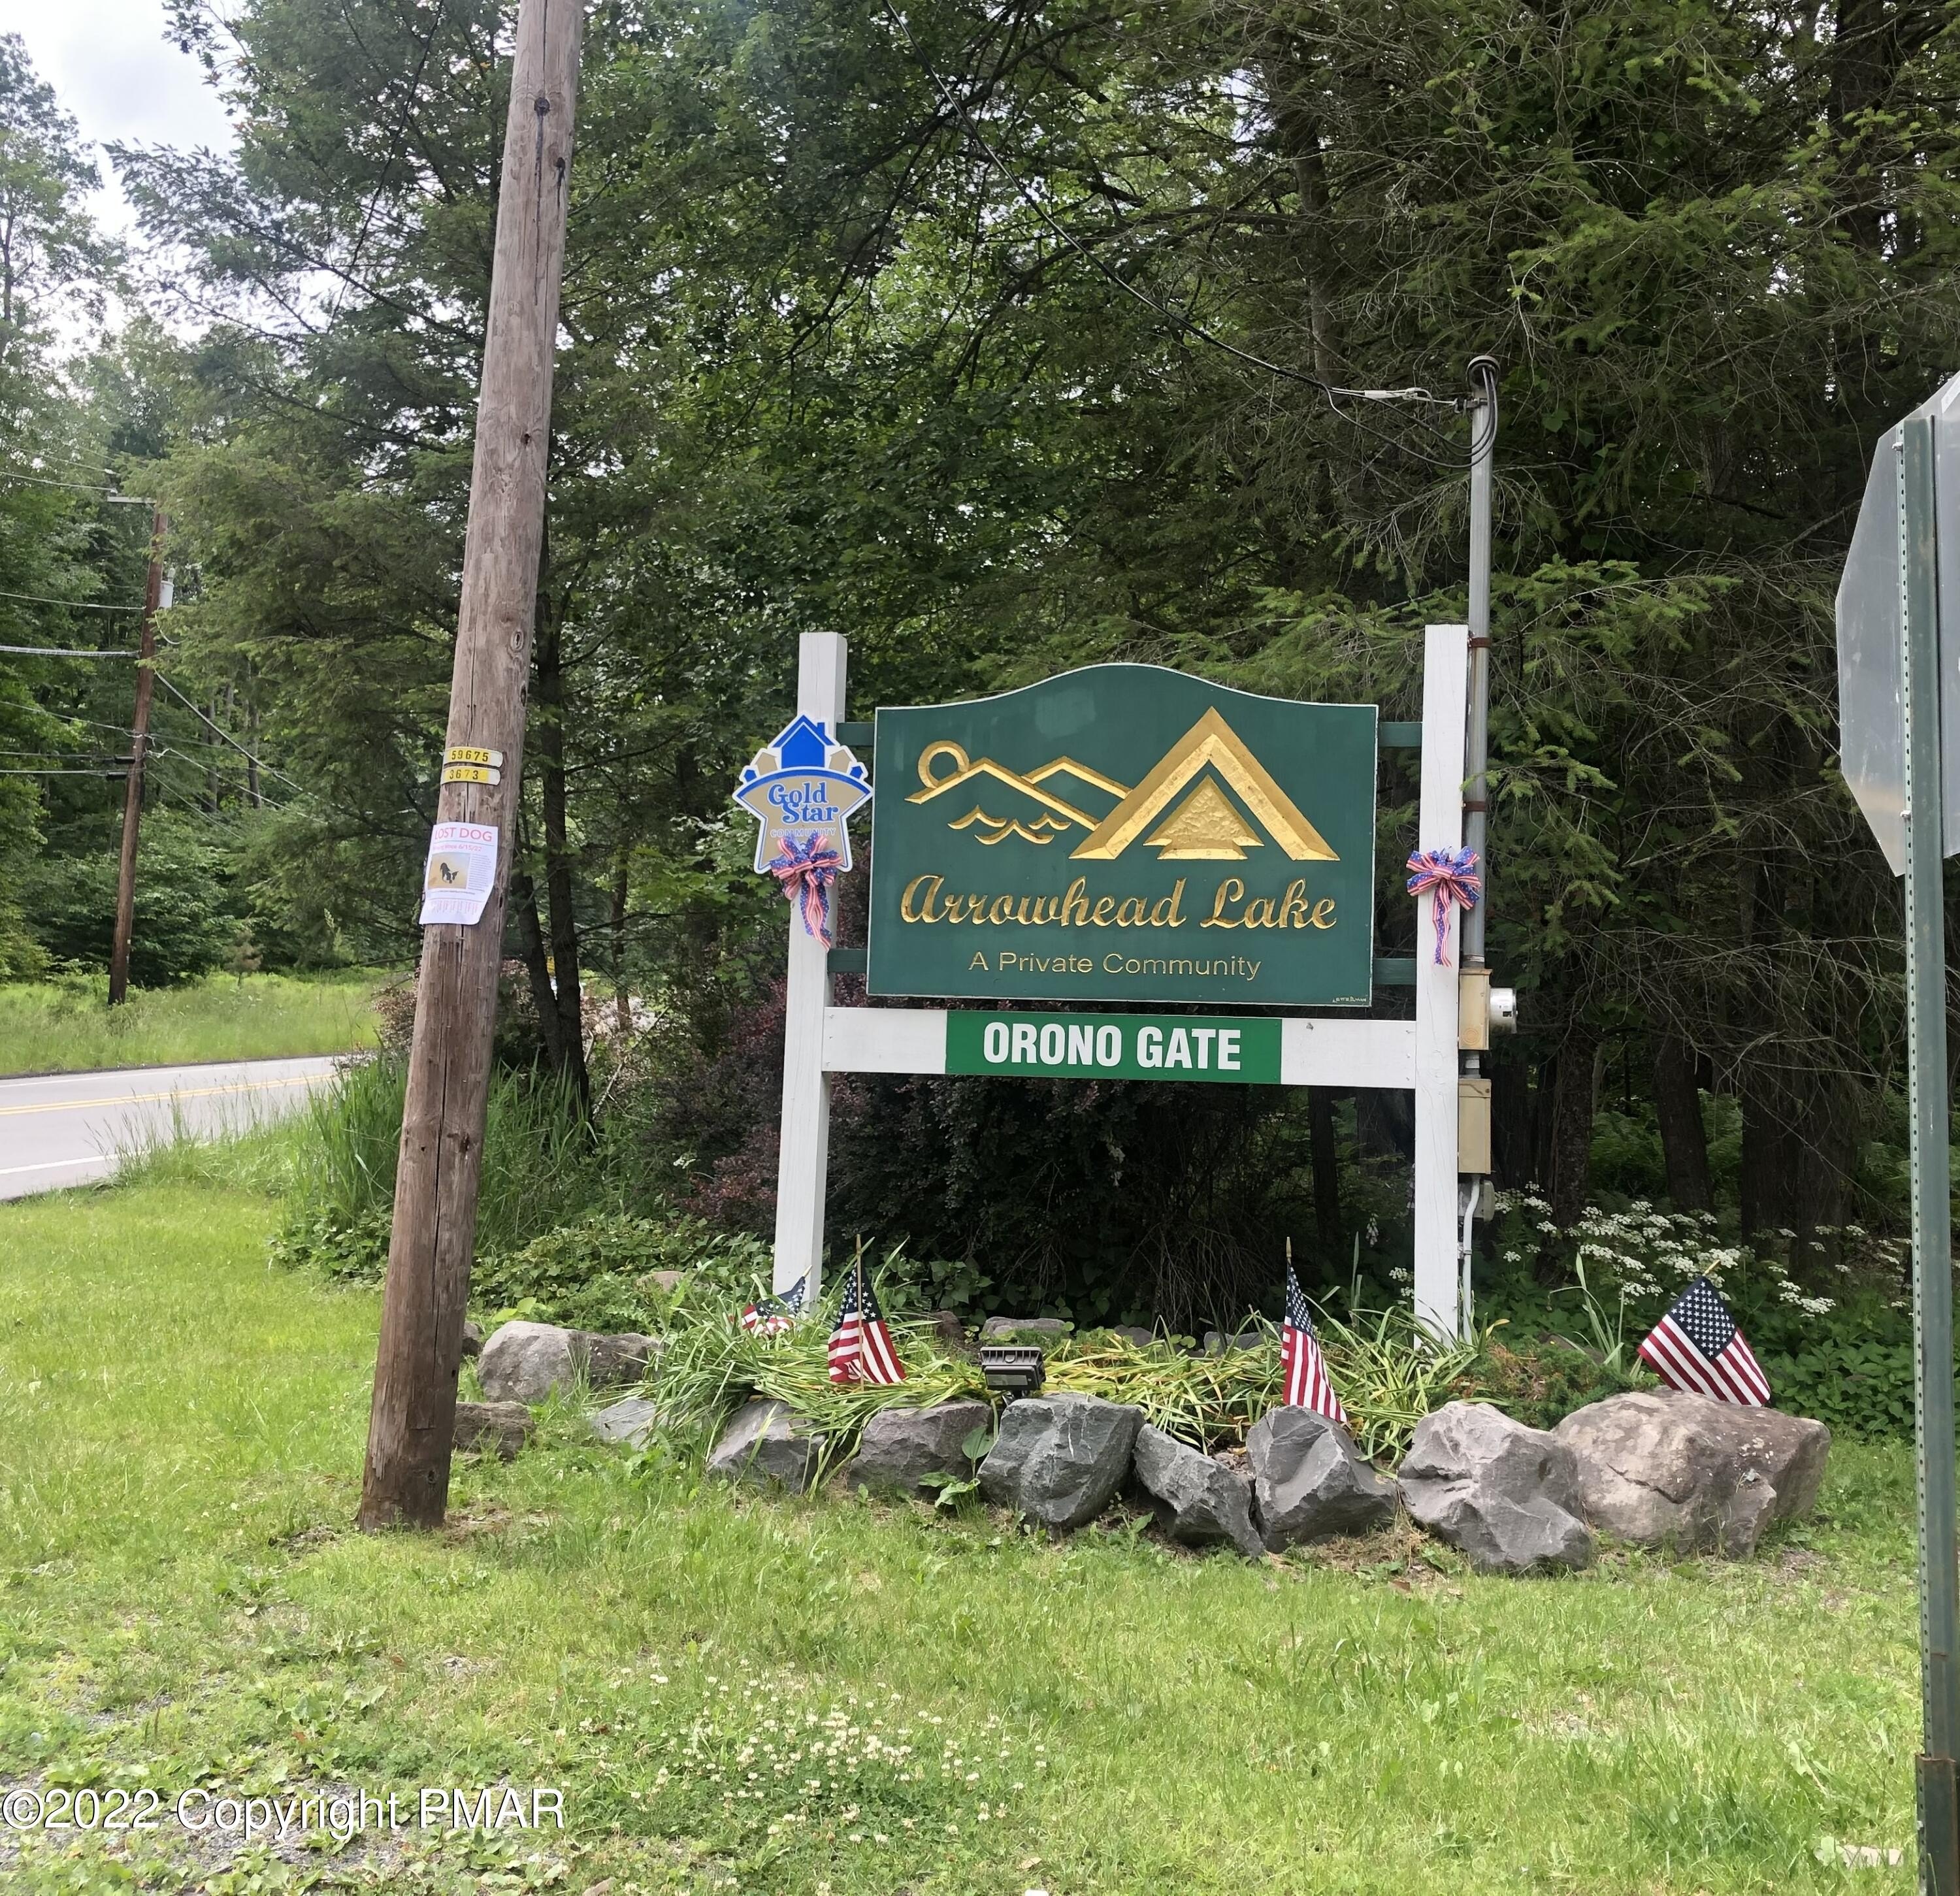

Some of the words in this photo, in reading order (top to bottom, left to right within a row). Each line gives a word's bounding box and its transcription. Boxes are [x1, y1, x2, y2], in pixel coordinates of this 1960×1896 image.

[451, 750, 489, 762] 59675
[449, 770, 478, 779] 3673
[768, 782, 827, 808] Gold
[782, 802, 839, 823] Star
[434, 827, 456, 840] LOST
[459, 828, 492, 842] DOG
[901, 874, 1187, 928] Arrowhead
[1200, 877, 1337, 929] Lake
[968, 951, 989, 971] A
[999, 952, 1093, 973] Private
[1103, 953, 1262, 981] Community
[983, 1022, 1122, 1068] ORONO
[1136, 1026, 1241, 1070] GATE
